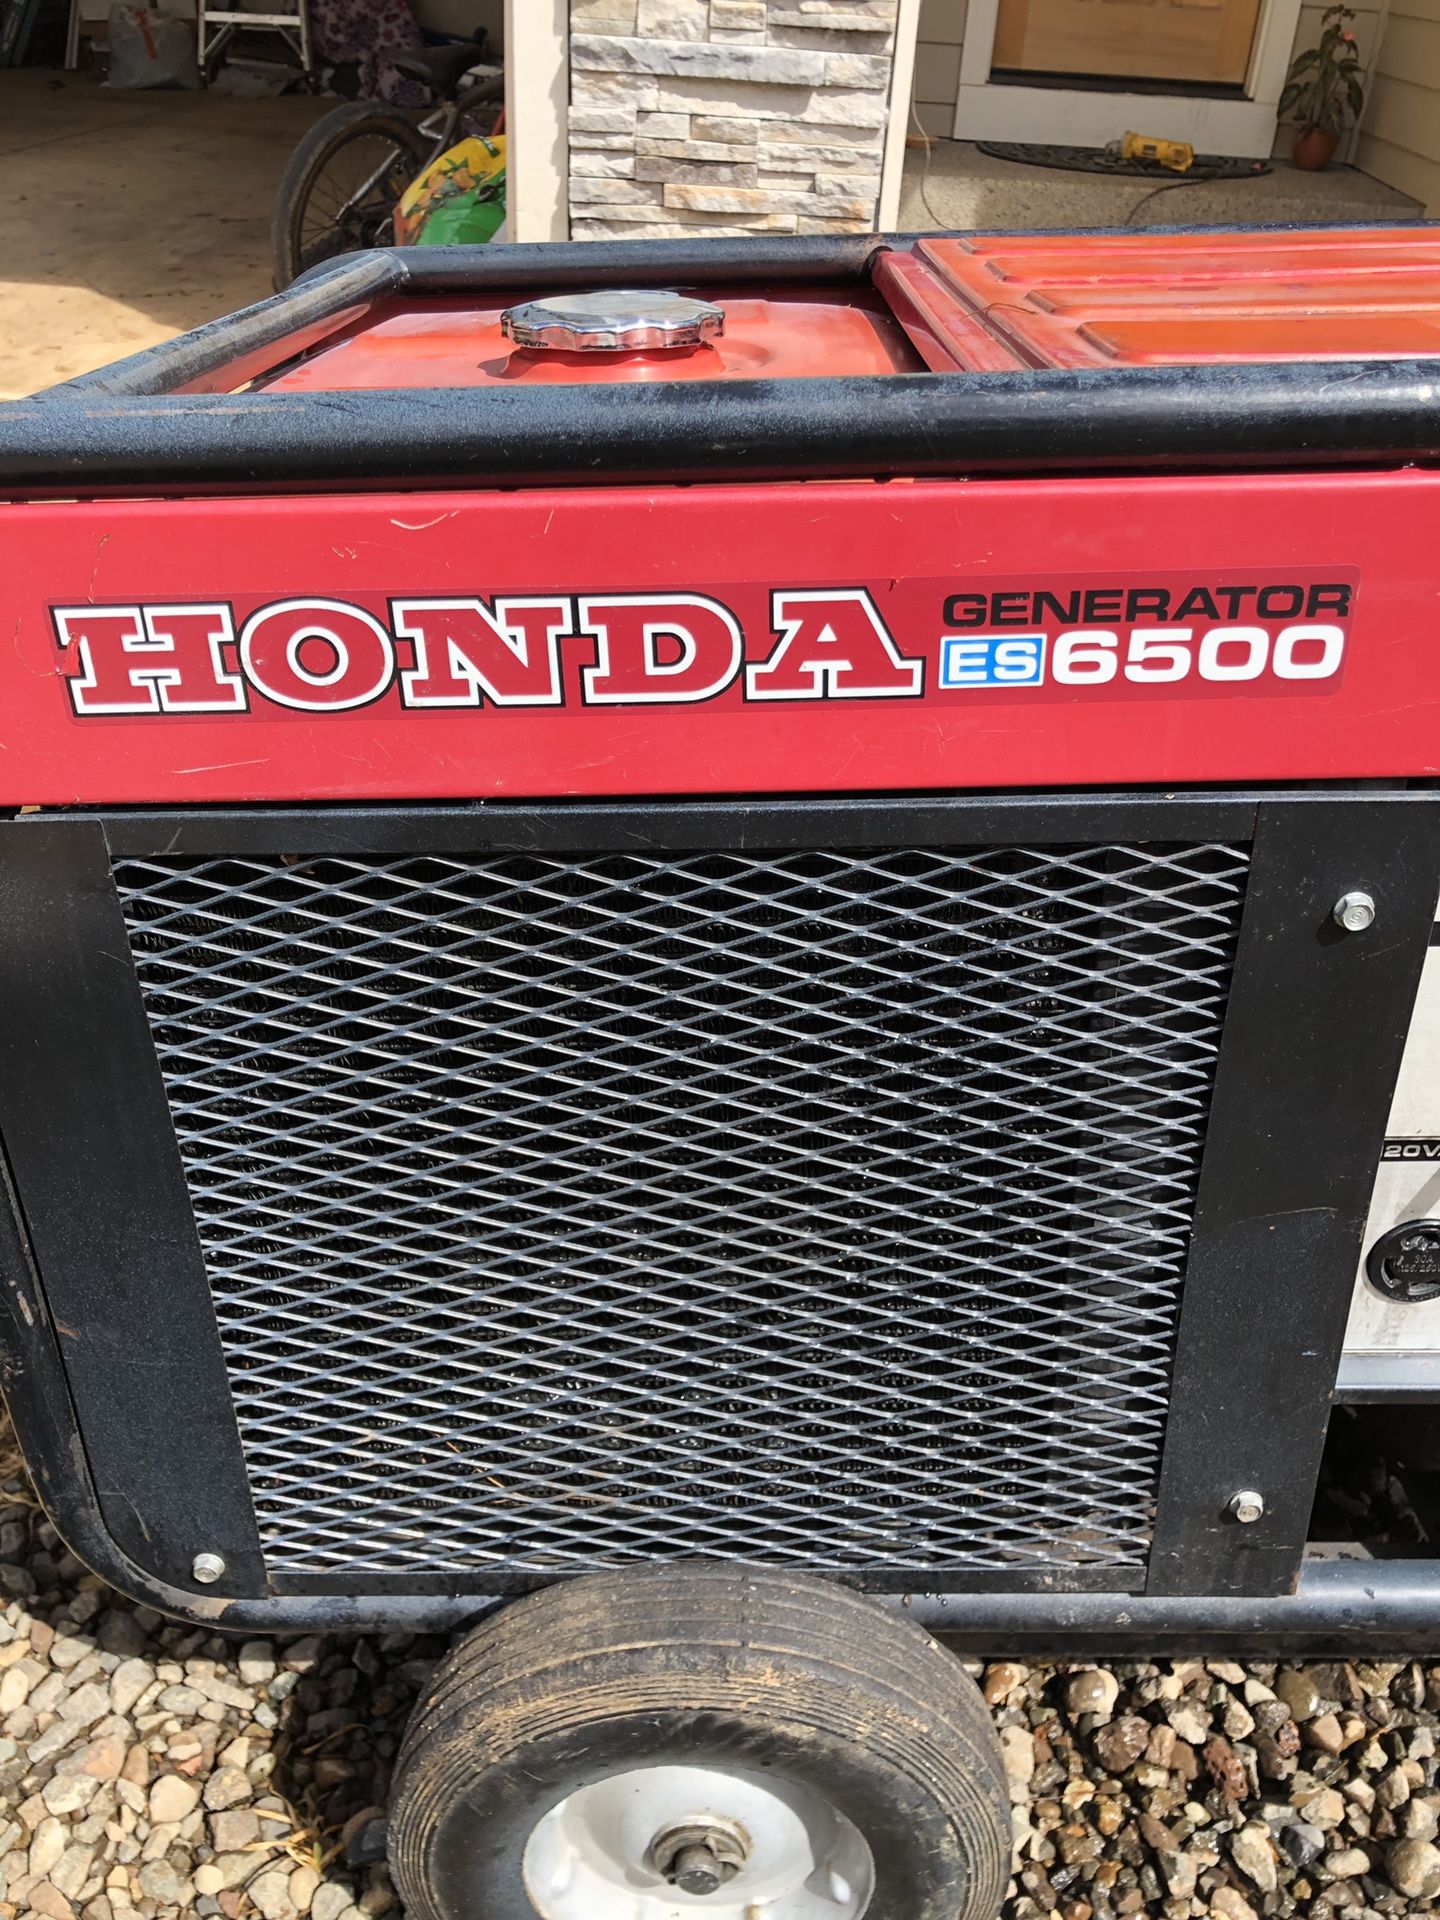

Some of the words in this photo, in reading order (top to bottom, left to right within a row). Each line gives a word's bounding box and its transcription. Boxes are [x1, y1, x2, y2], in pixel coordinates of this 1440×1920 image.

[943, 584, 1352, 627] GENERATOR
[49, 586, 926, 717] HONDA
[1383, 1144, 1440, 1158] 20V
